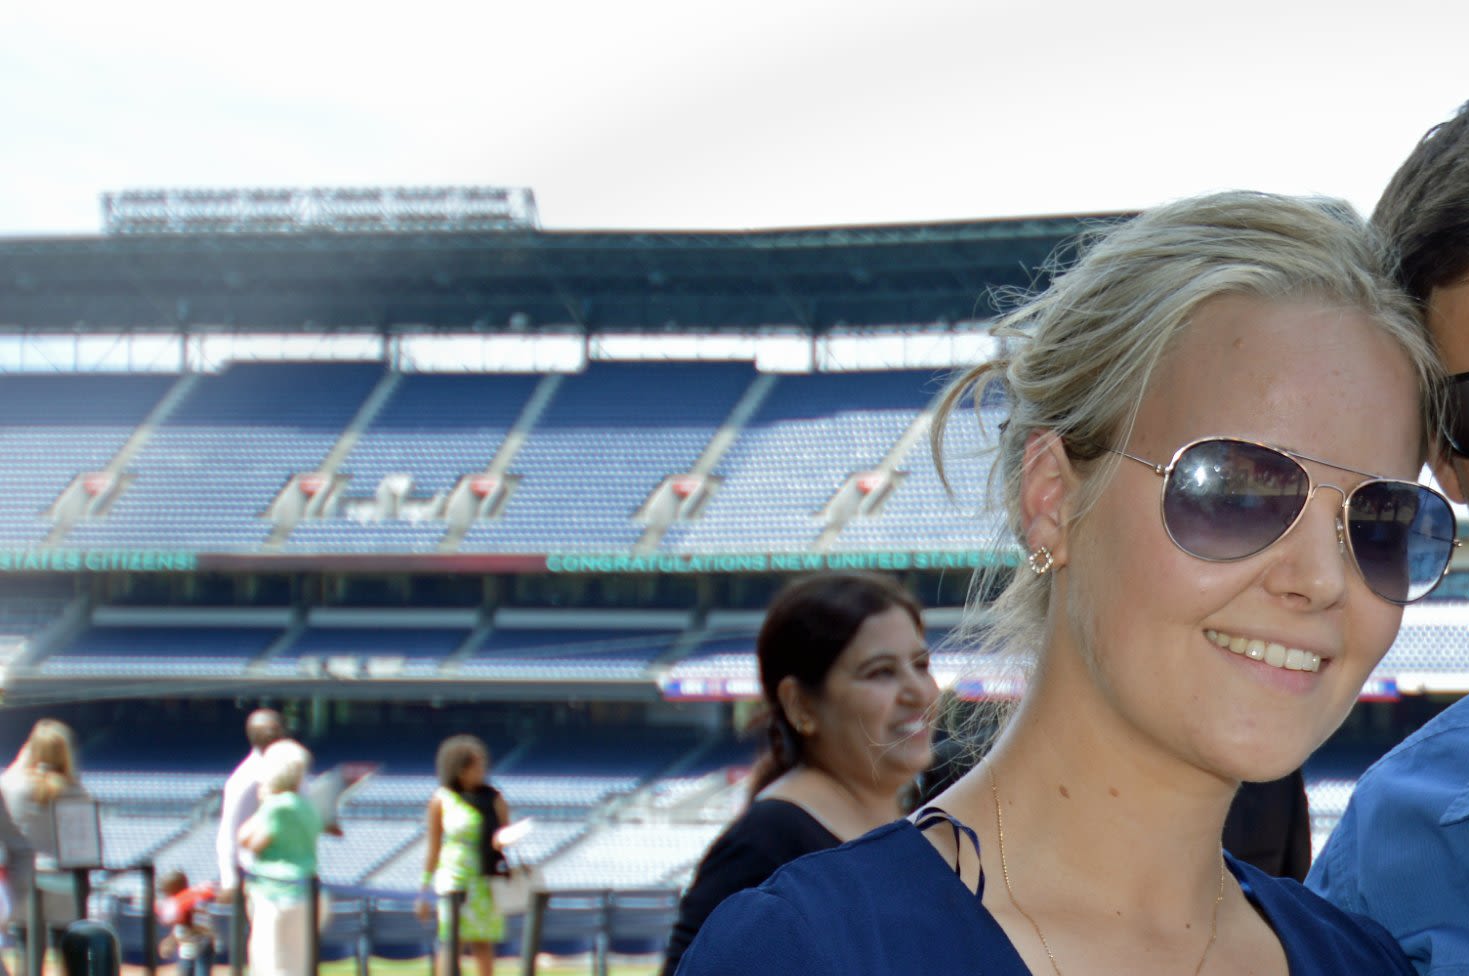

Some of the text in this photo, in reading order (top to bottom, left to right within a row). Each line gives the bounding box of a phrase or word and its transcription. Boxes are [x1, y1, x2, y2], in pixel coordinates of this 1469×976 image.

[85, 548, 195, 572] CITIZENS!
[545, 552, 767, 573] CONGRATULATIONS
[770, 551, 825, 571] NEW
[827, 549, 908, 570] UNITED
